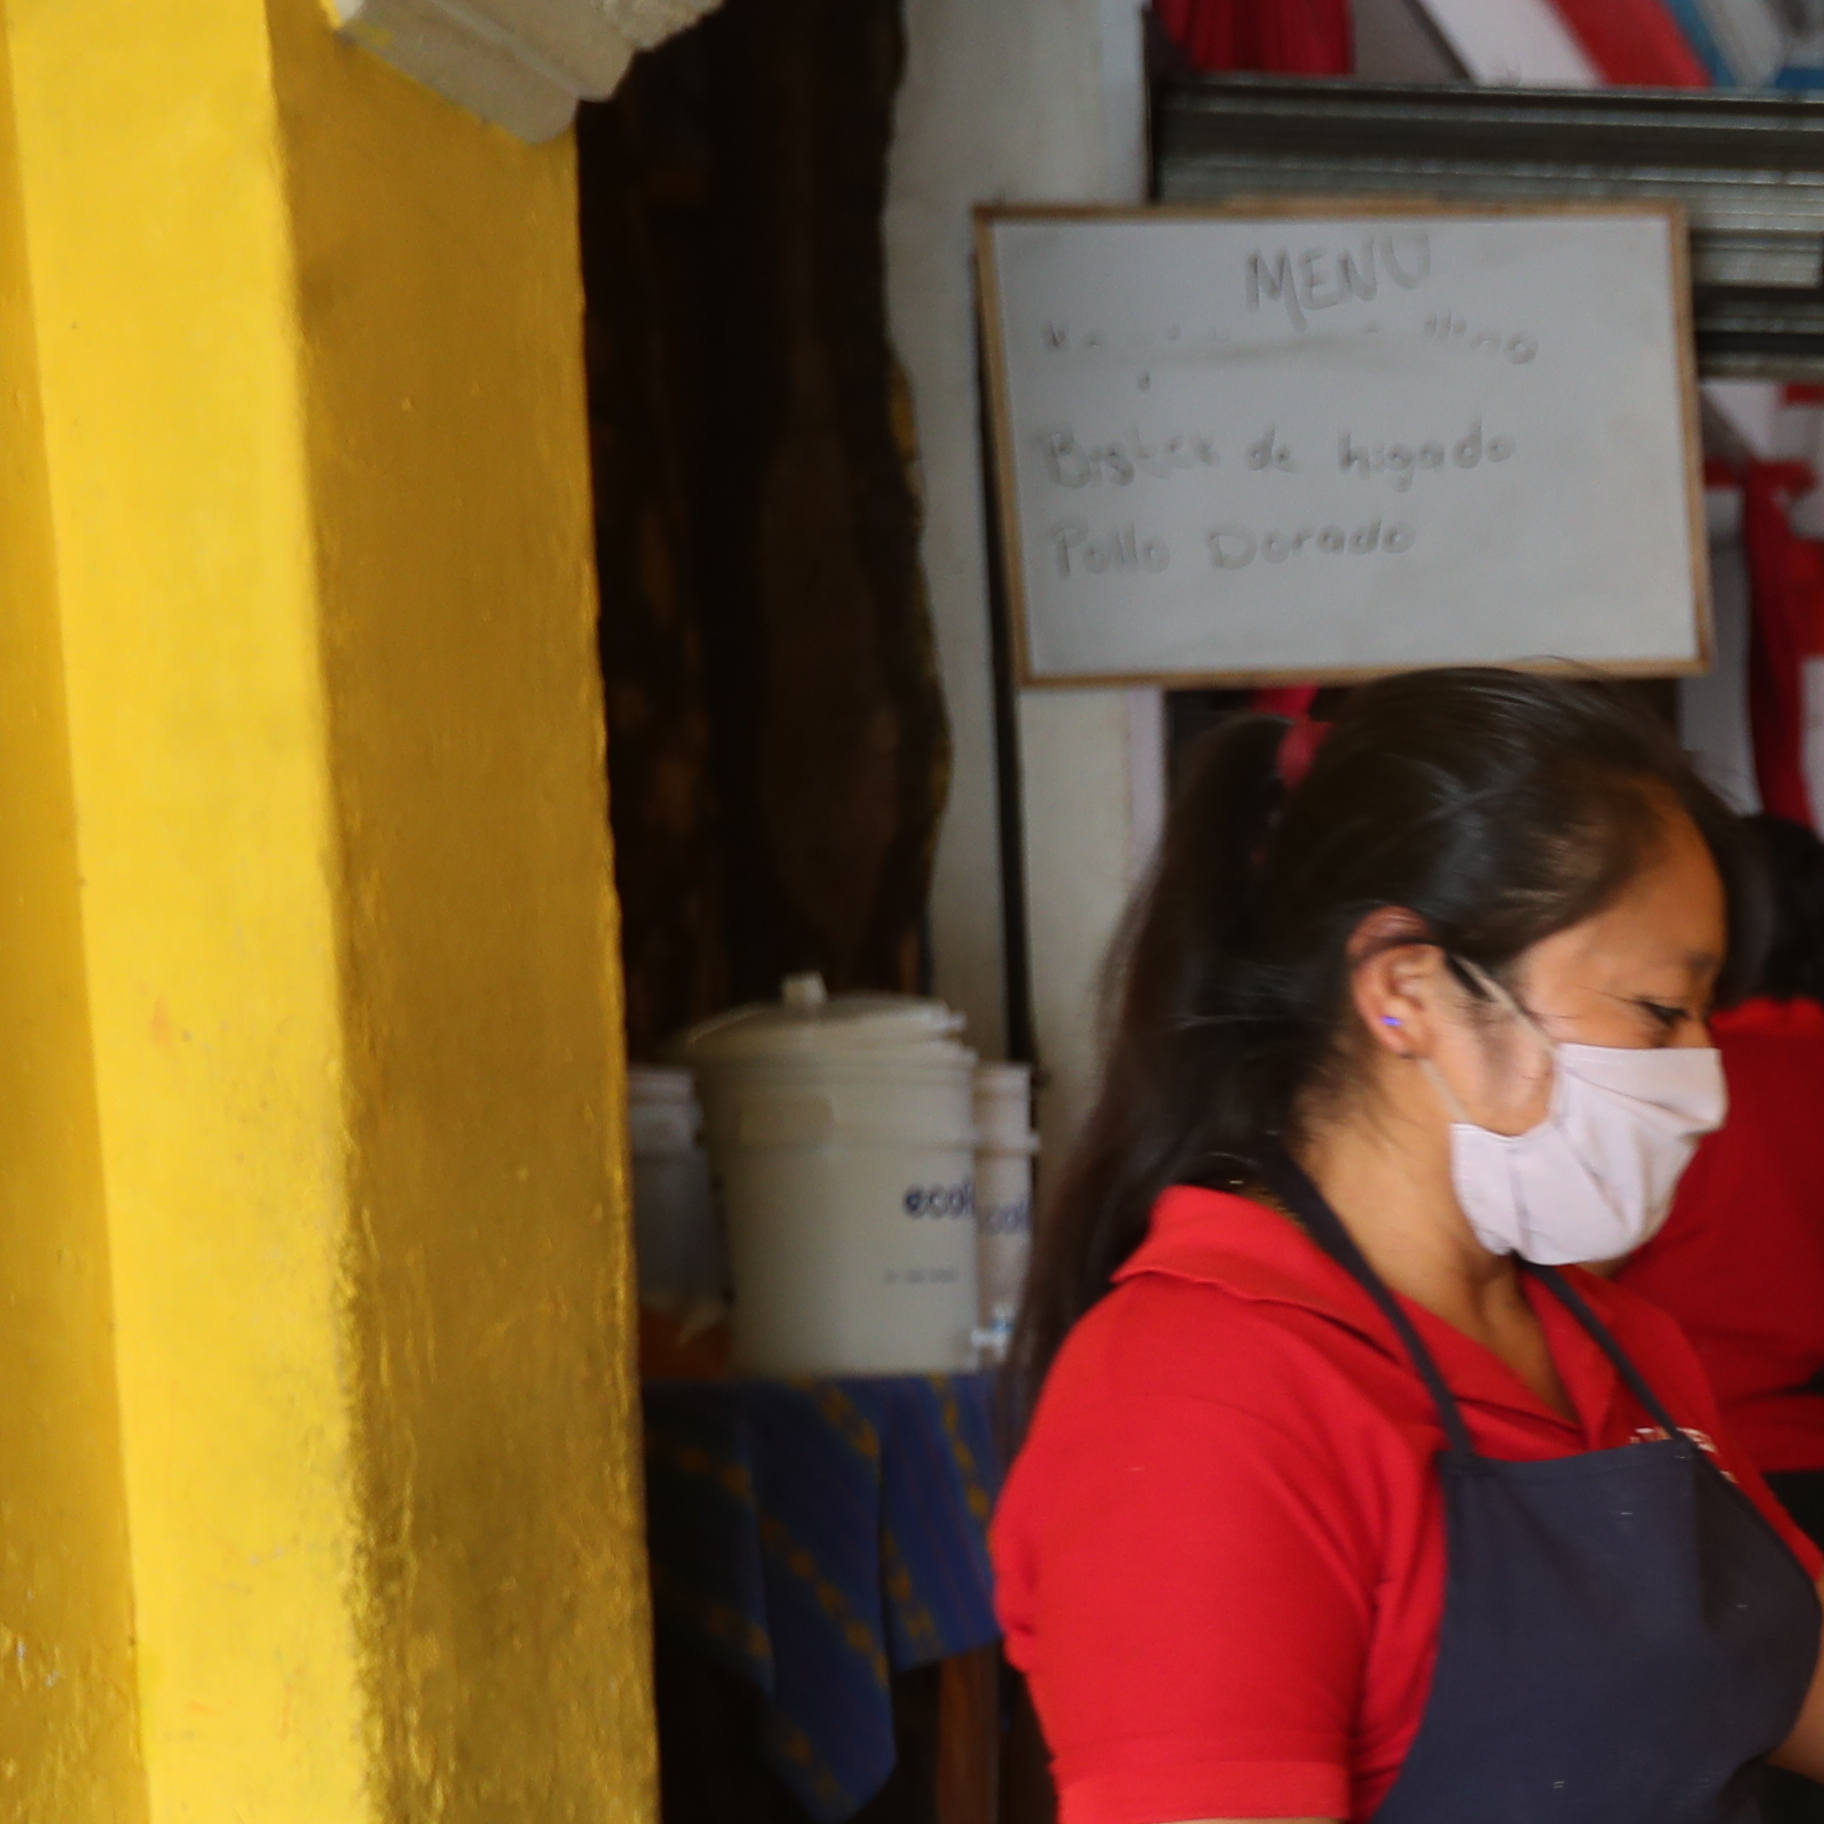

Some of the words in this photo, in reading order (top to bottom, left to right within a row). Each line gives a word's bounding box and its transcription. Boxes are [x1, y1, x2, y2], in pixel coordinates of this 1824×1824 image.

[1244, 228, 1433, 332] MENU
[1245, 424, 1297, 472] de
[1048, 515, 1171, 578] Pollo
[1207, 515, 1415, 570] Dorado
